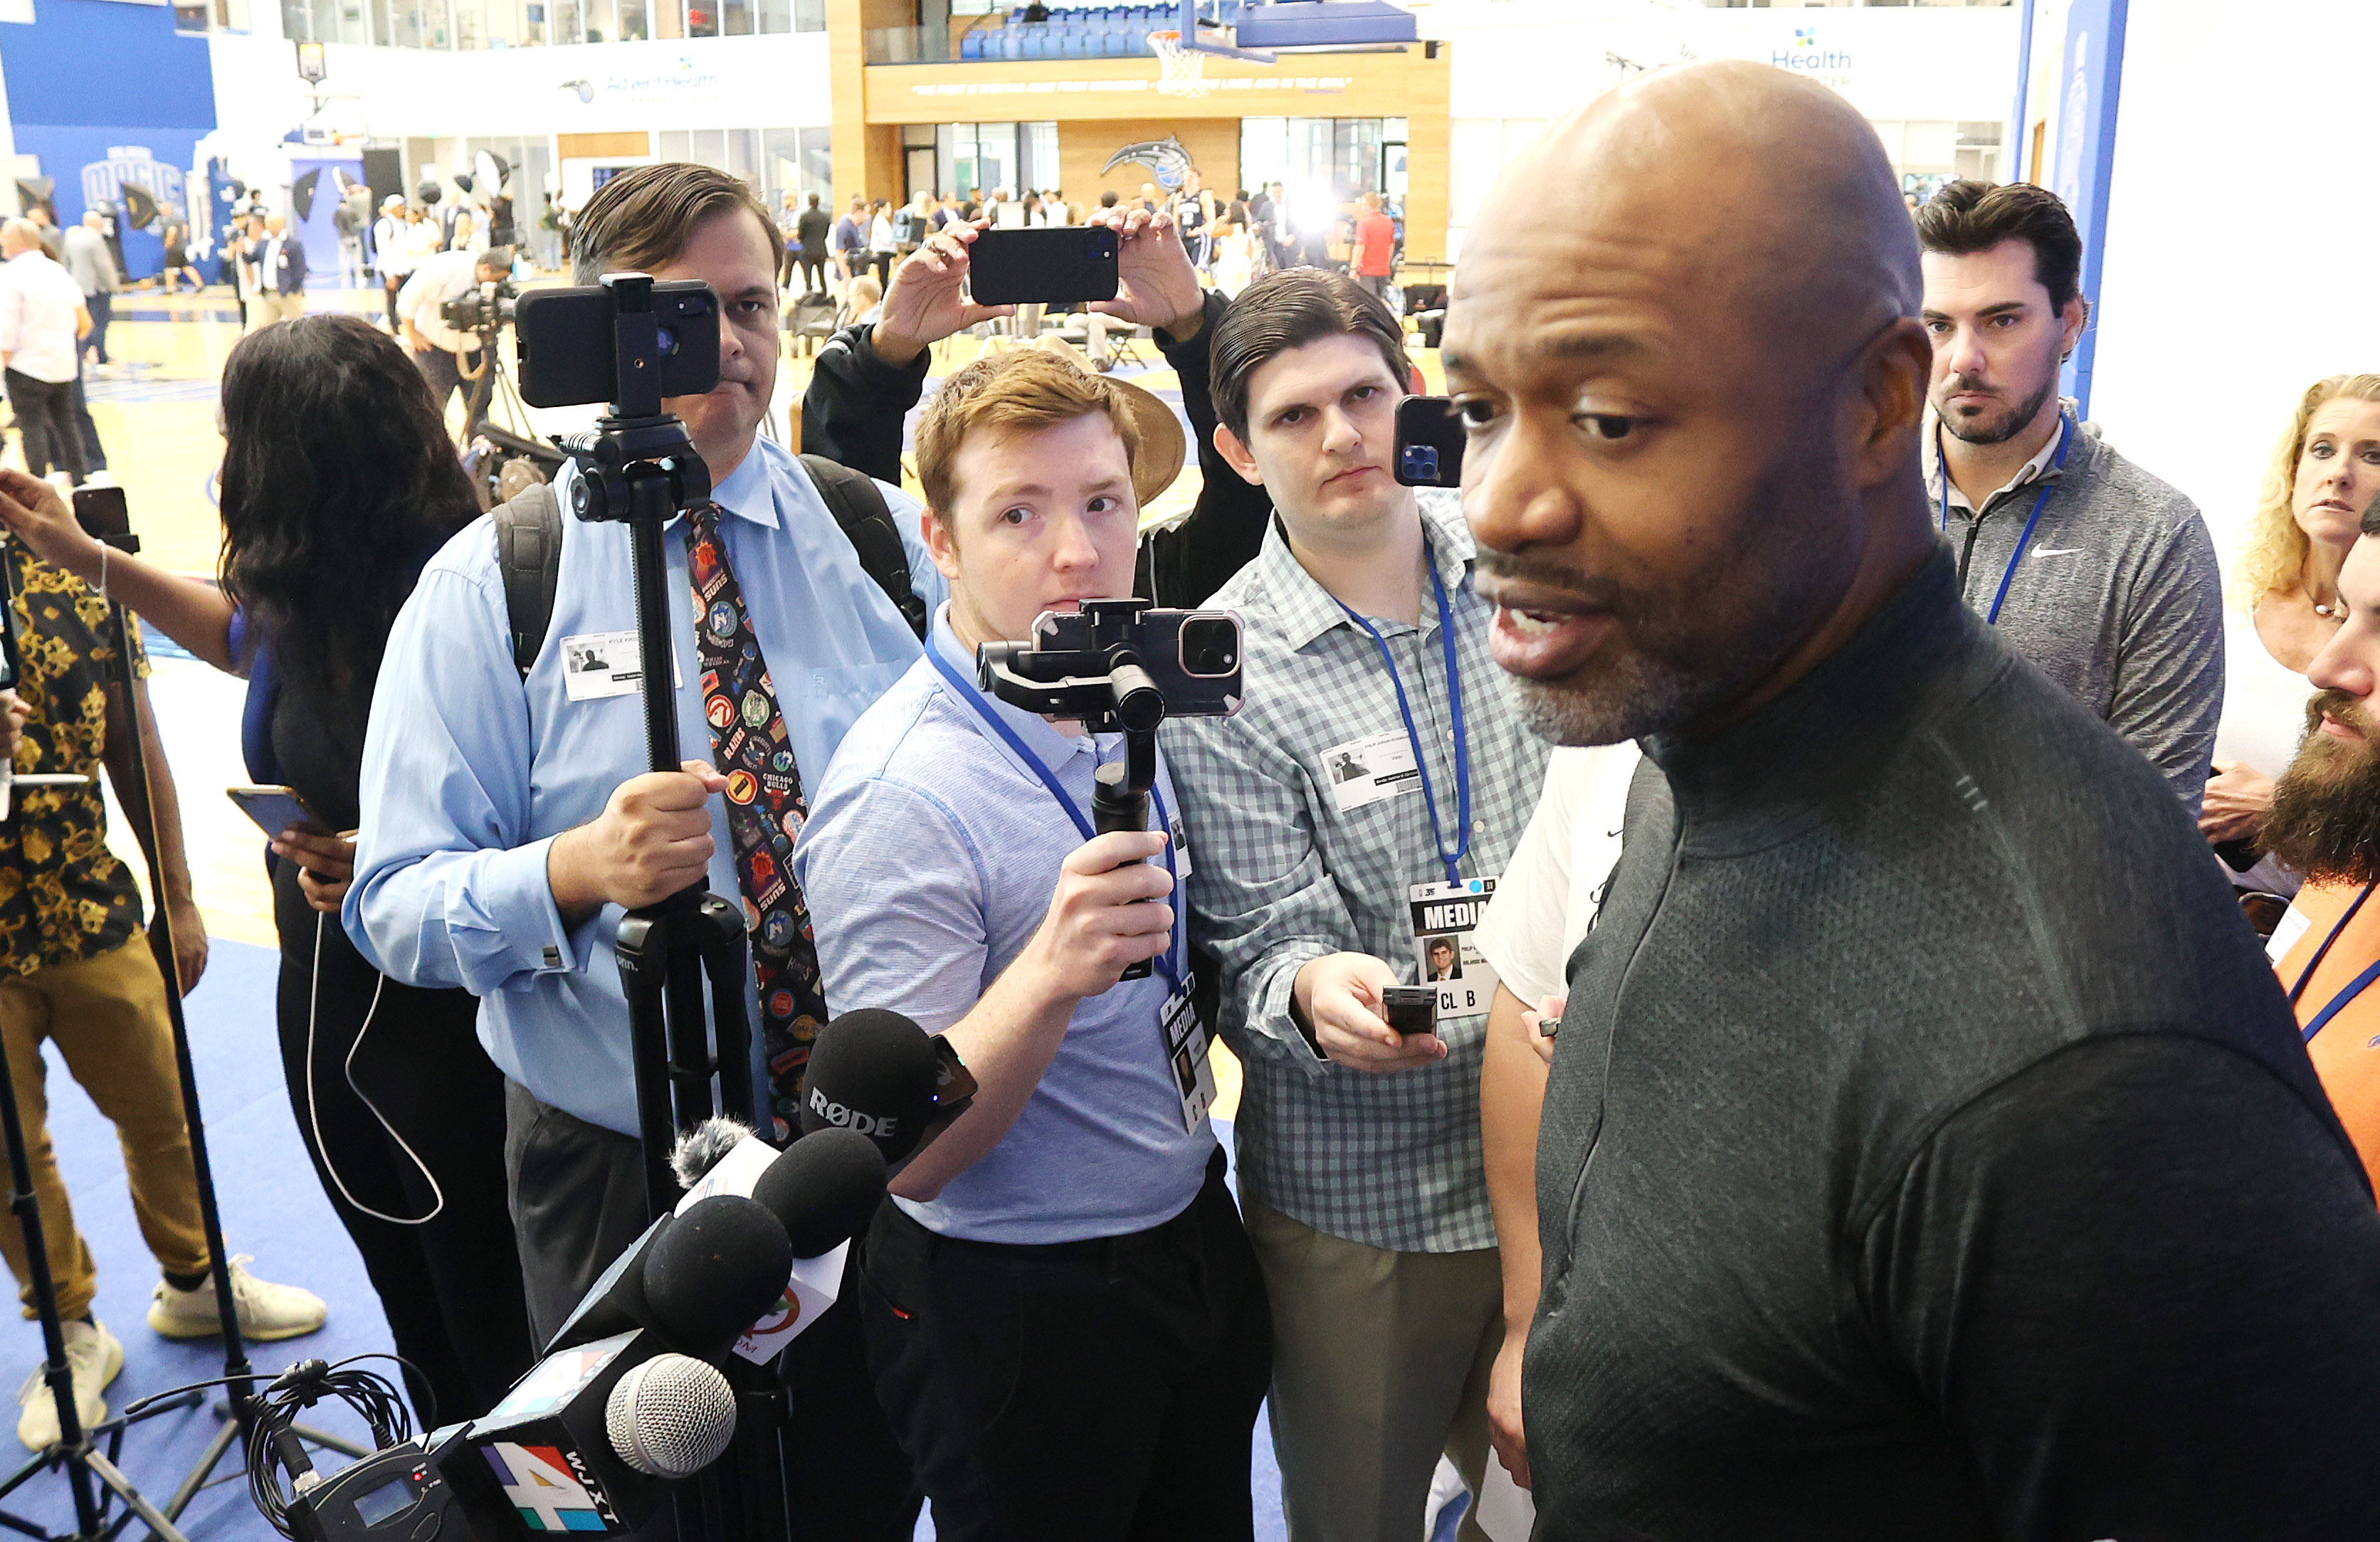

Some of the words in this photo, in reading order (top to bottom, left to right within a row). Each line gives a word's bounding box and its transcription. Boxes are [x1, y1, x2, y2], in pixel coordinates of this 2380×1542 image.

[704, 573, 729, 603] SUNS
[723, 727, 747, 761] BLAZERS
[763, 773, 794, 785] CHICAGO
[767, 779, 789, 790] BULLS
[760, 882, 787, 912] SUNS
[1441, 993, 1458, 1010] CL
[1466, 990, 1476, 1008] B
[1169, 1000, 1196, 1047] MEDIA
[809, 1087, 899, 1139] RØDE
[492, 1442, 597, 1532] 4
[565, 1450, 620, 1524] WJXT
